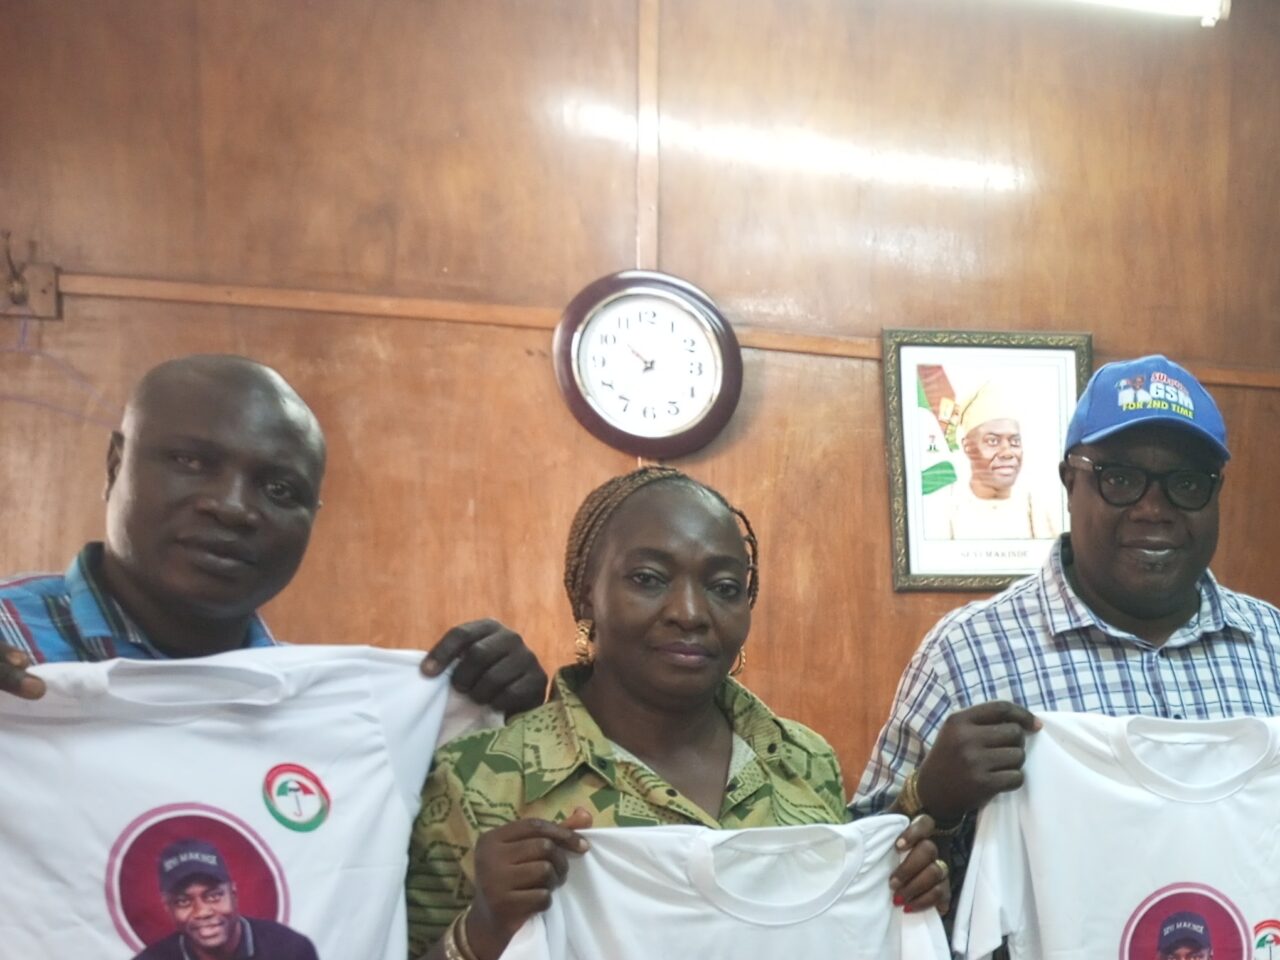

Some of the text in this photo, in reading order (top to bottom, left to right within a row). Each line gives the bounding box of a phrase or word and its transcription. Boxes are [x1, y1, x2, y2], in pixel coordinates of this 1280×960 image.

[638, 311, 657, 325] 12
[600, 333, 616, 344] 10
[683, 338, 695, 352] 2
[618, 395, 630, 412] 7
[1149, 382, 1194, 411] GSM
[642, 405, 656, 419] 6
[1171, 403, 1194, 420] TIME
